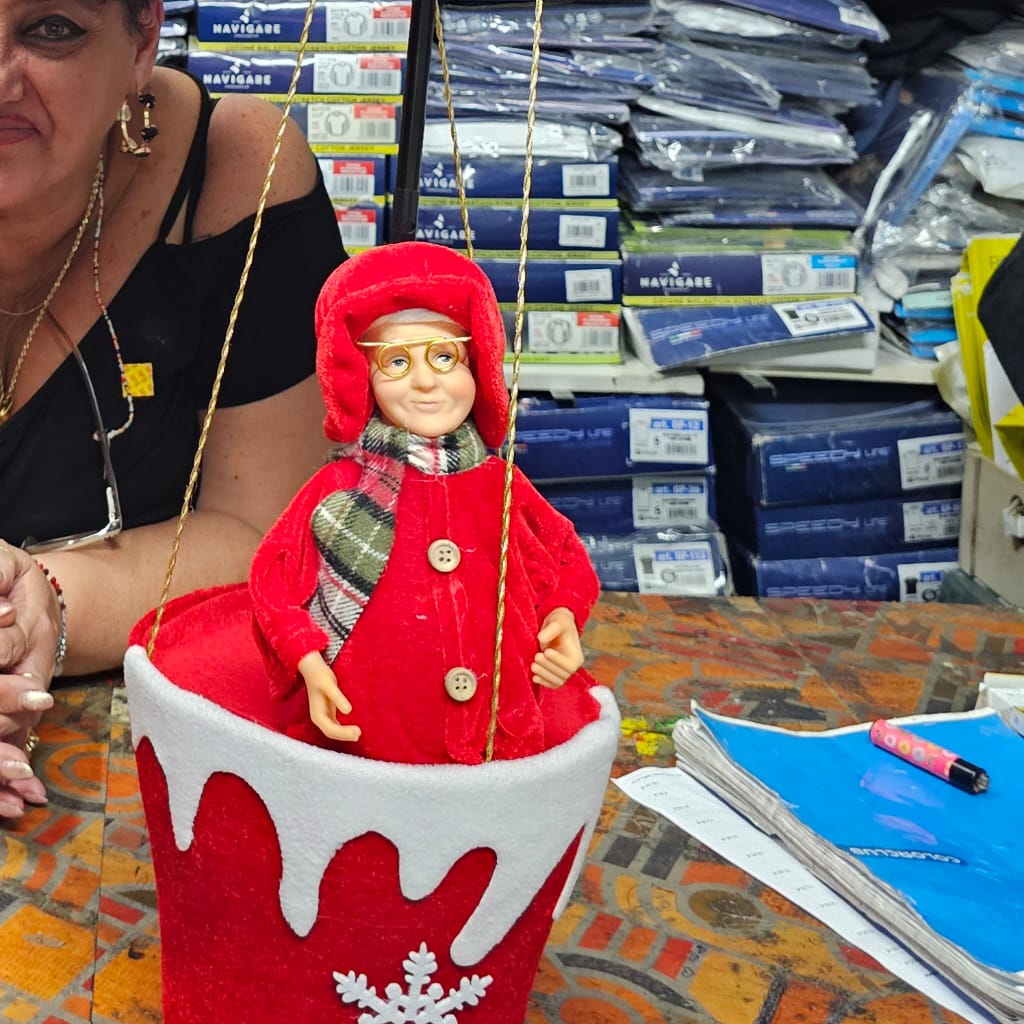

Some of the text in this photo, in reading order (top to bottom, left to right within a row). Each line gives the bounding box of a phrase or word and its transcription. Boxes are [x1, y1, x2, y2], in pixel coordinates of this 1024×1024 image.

[212, 24, 281, 35] NAVIGARE
[203, 74, 272, 85] NAVIGARE
[418, 177, 475, 189] AVIGAE
[416, 229, 476, 241] AVIGARE
[639, 276, 713, 288] NAVIGARE
[769, 448, 861, 465] SPEEDY
[765, 517, 860, 533] SPEEDY
